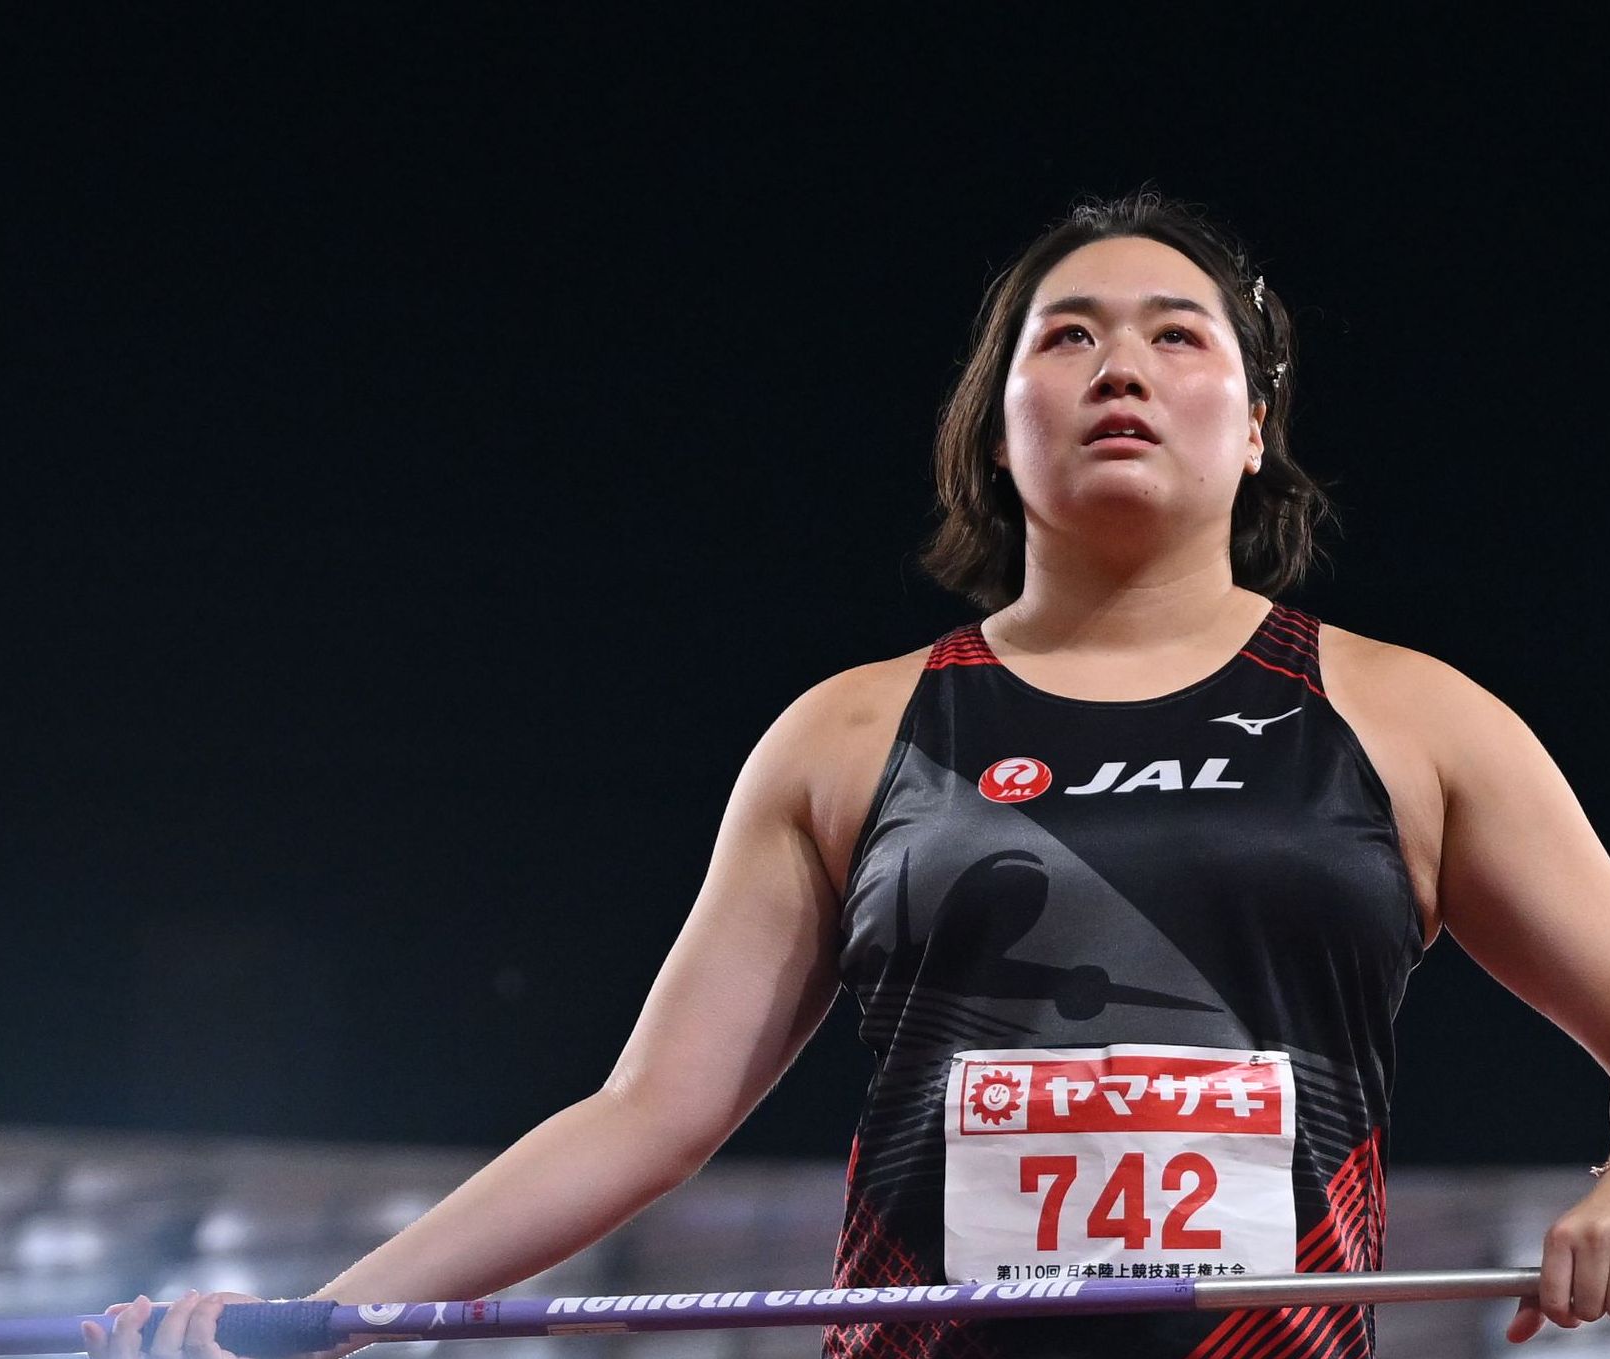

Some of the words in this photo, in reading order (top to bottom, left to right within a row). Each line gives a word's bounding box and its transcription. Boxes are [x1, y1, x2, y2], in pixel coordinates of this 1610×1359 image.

[998, 786, 1035, 798] JAL
[1063, 758, 1245, 796] JAL
[1045, 1074, 1265, 1118] ヤマザキ
[1020, 1152, 1221, 1251] 742
